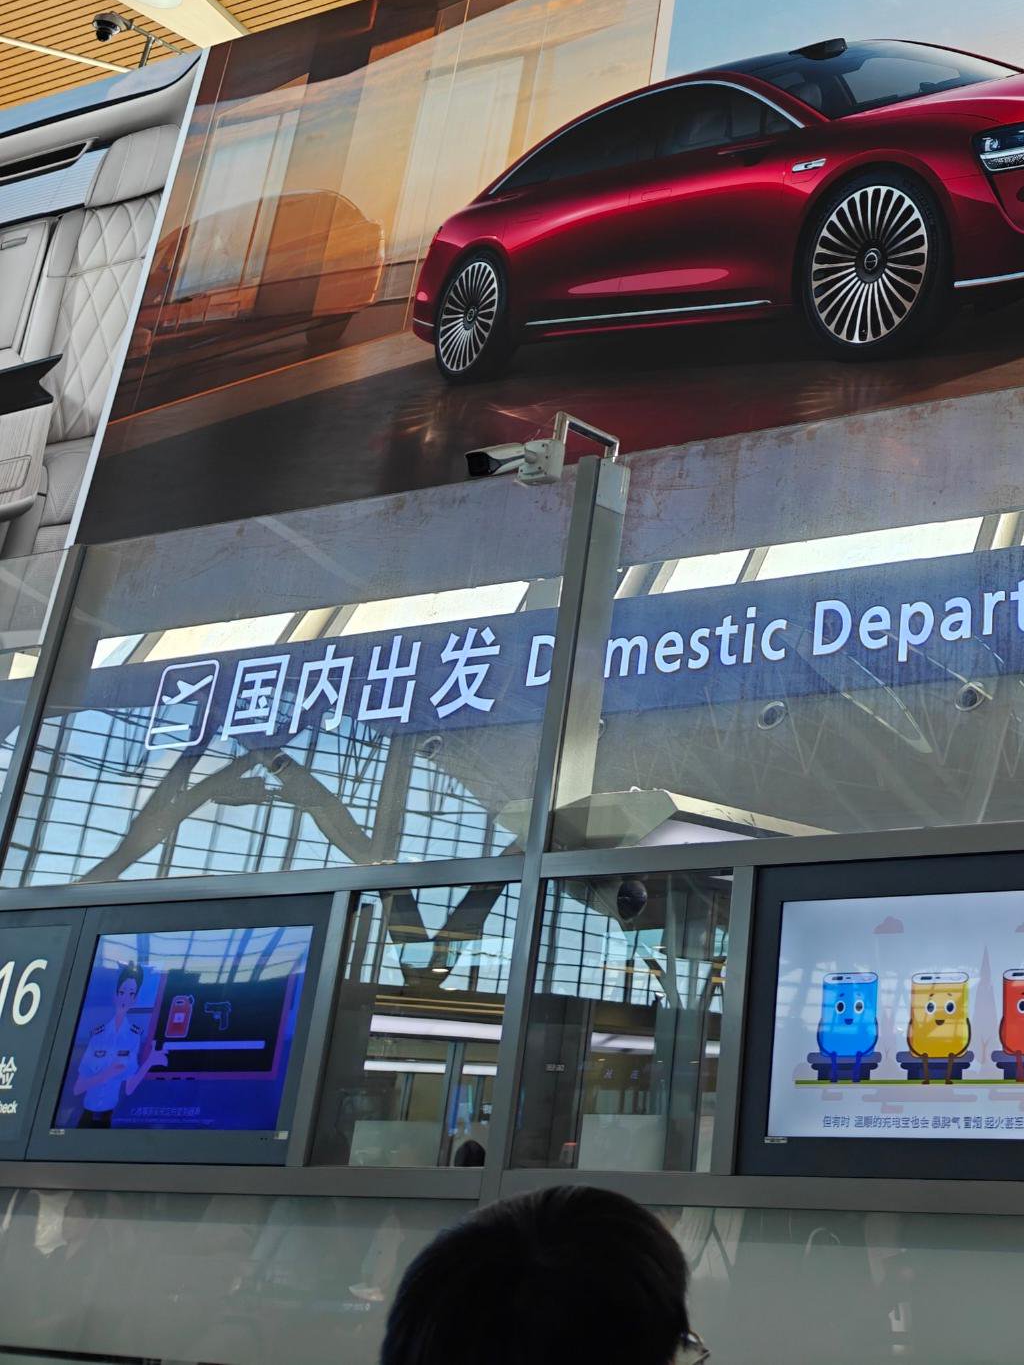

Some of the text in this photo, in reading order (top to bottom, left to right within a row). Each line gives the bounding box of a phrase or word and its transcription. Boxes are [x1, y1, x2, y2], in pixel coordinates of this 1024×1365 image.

[220, 626, 502, 742] 国内出发
[526, 605, 788, 687] Dmestic
